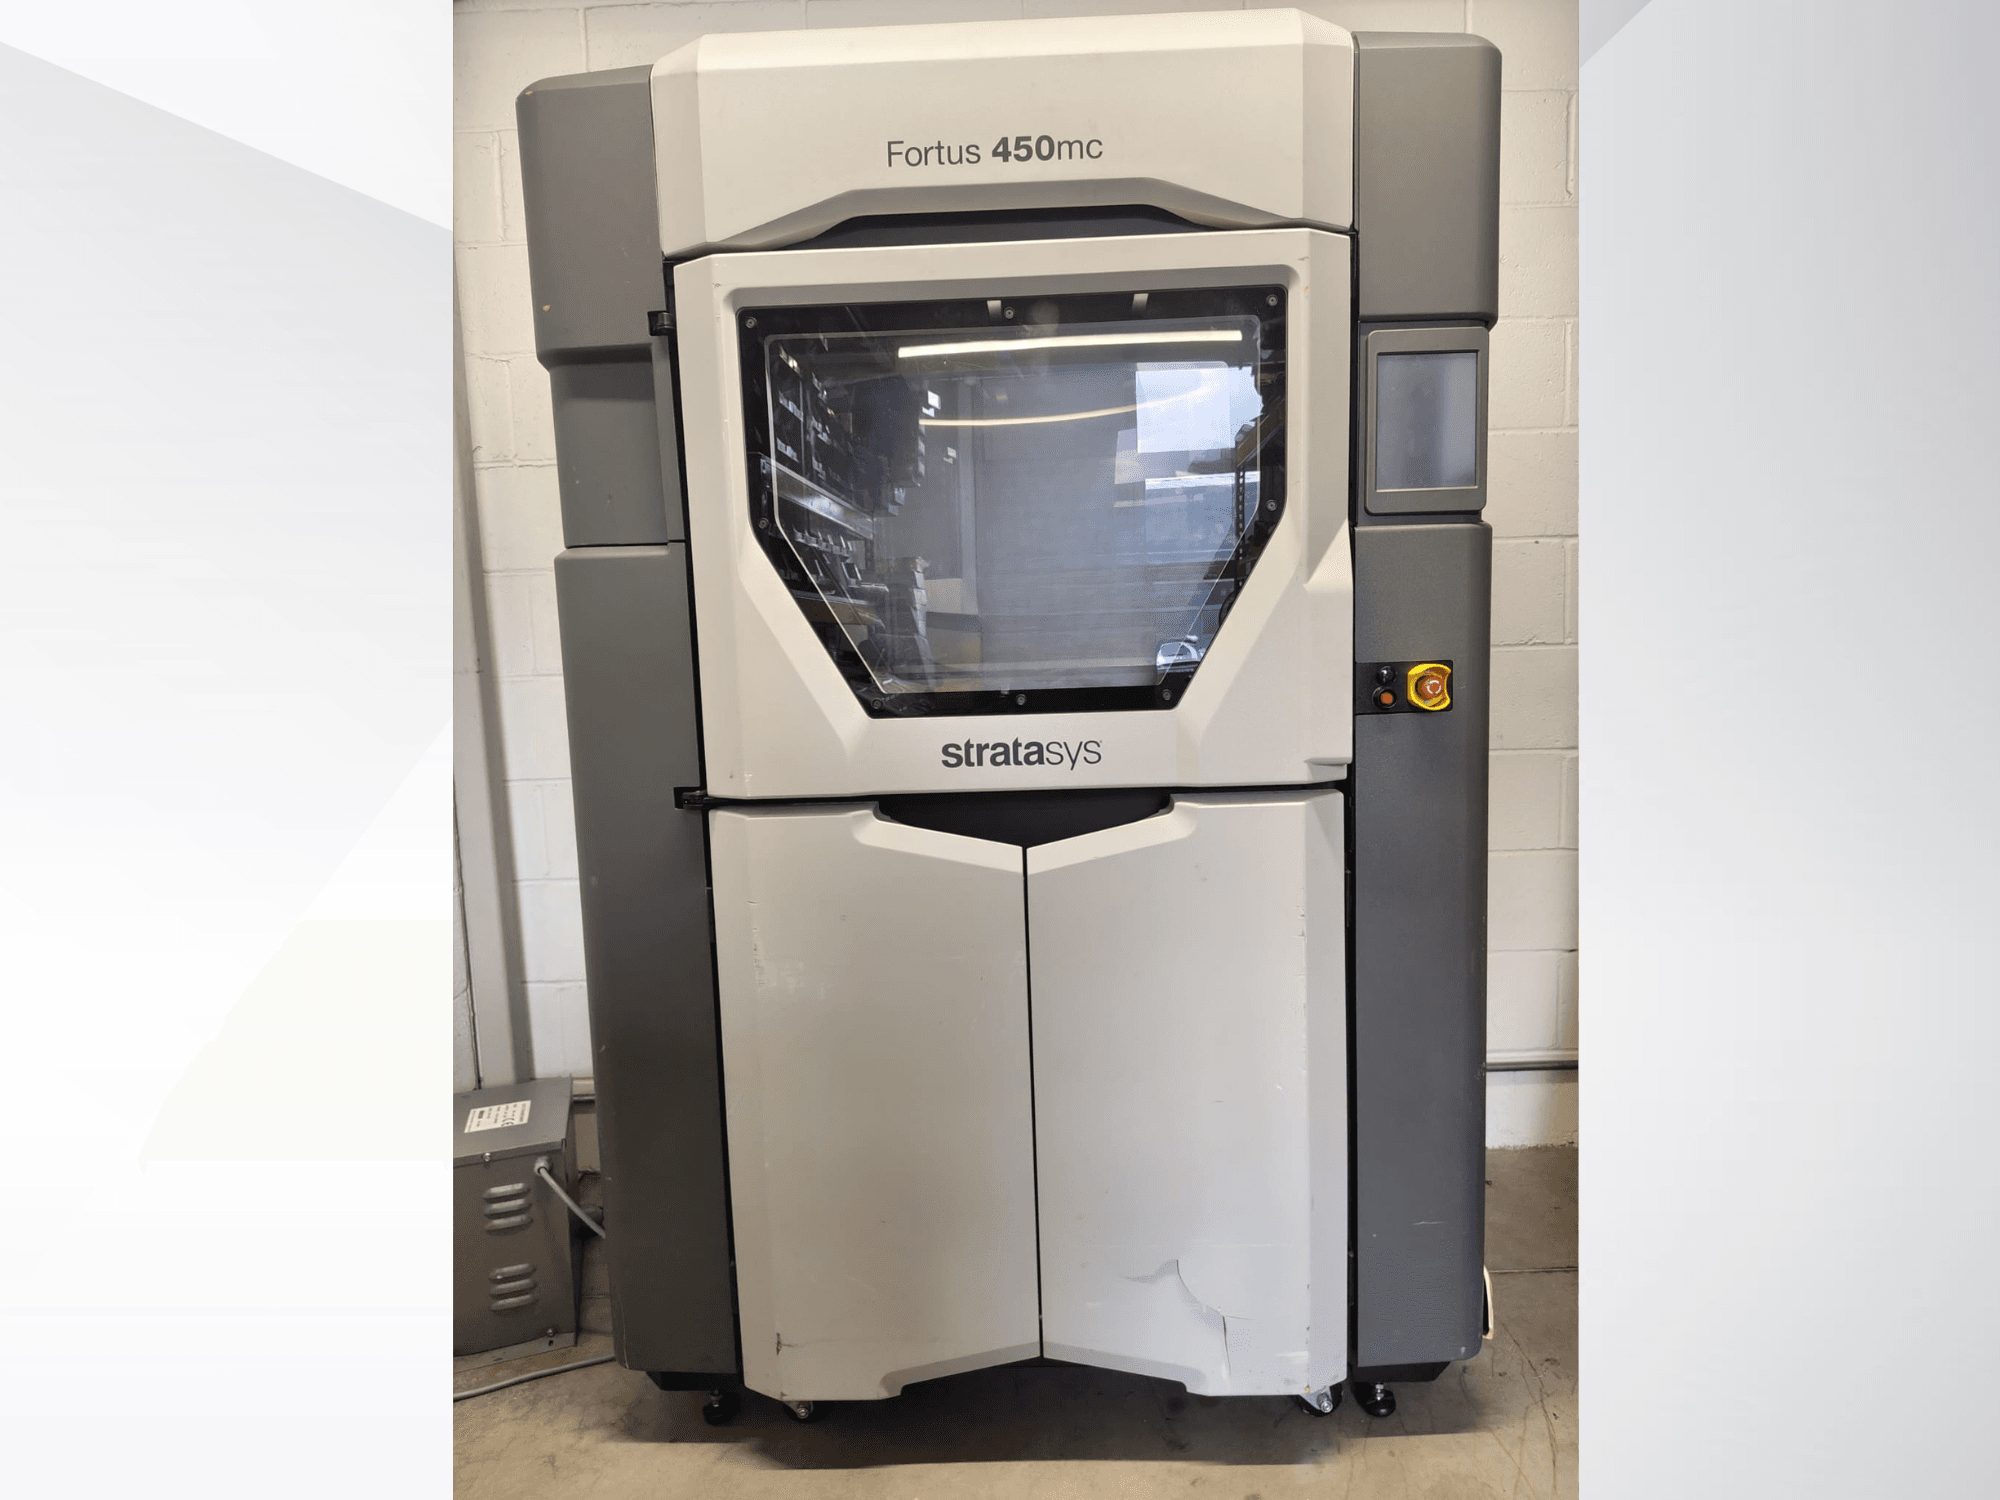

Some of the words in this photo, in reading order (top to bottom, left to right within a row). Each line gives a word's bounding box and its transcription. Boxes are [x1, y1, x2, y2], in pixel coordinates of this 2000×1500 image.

[887, 140, 981, 168] Fortus
[991, 134, 1103, 163] 450mc
[941, 737, 1102, 771] stratasys
